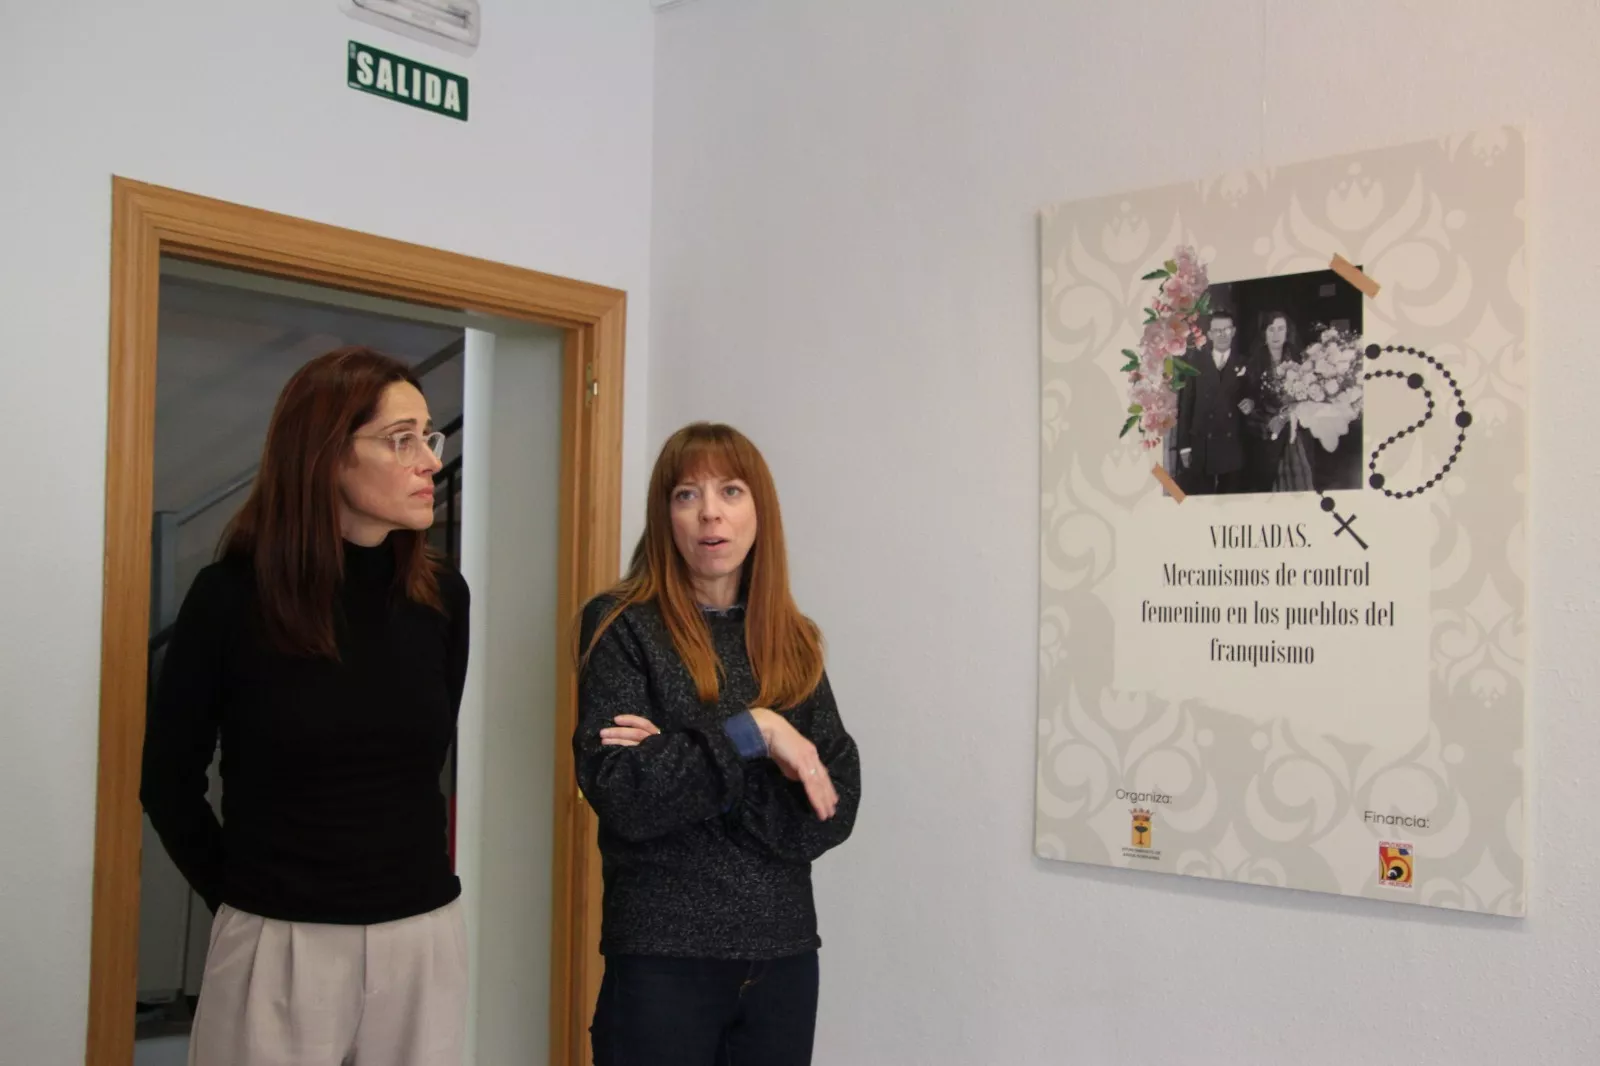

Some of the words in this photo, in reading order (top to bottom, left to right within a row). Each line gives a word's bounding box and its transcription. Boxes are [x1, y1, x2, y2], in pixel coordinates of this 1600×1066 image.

[356, 51, 461, 113] SALIDA
[1210, 523, 1312, 549] VIGILADAS.
[1162, 563, 1270, 587] Mecanismos
[1275, 562, 1297, 587] de
[1303, 561, 1370, 587] control
[1141, 600, 1221, 624] femenino
[1226, 606, 1247, 625] en
[1254, 600, 1280, 625] los
[1286, 601, 1359, 630] pueblos
[1365, 601, 1394, 627] del
[1210, 638, 1315, 667] franquismo
[1115, 788, 1172, 804] Organiza:
[1363, 810, 1430, 828] Financia:
